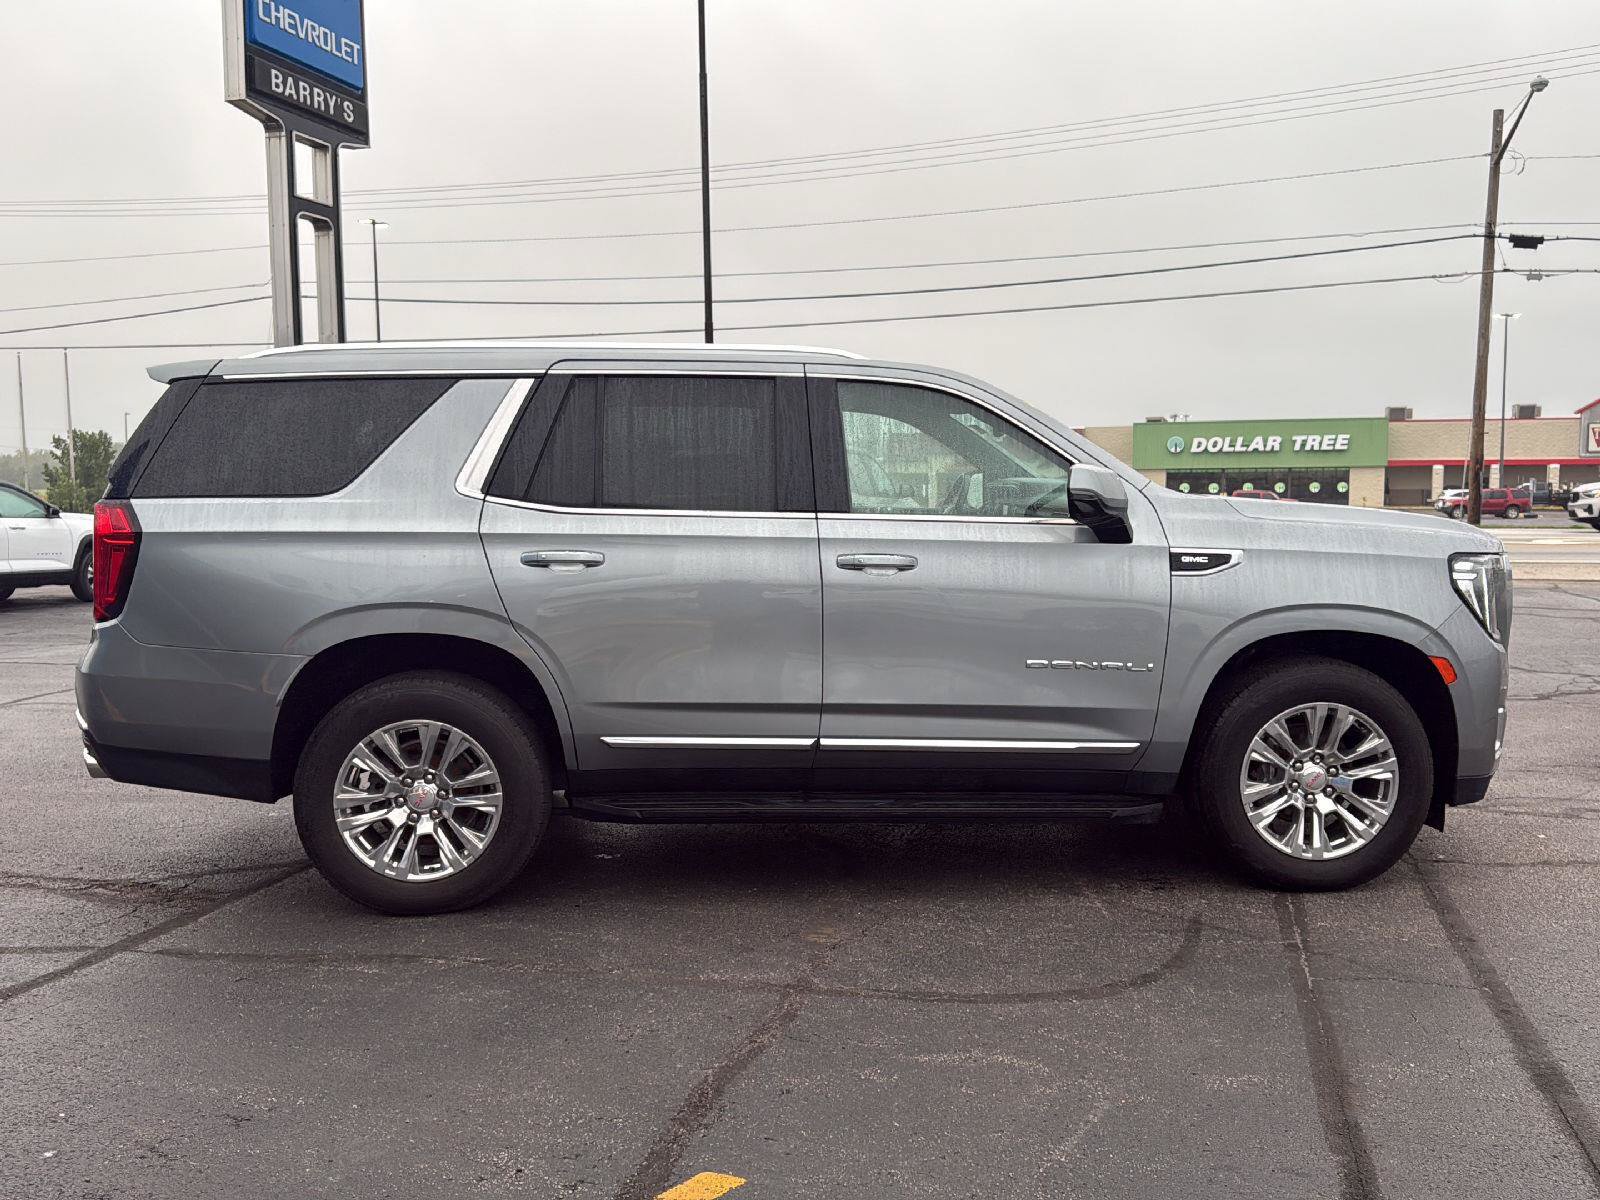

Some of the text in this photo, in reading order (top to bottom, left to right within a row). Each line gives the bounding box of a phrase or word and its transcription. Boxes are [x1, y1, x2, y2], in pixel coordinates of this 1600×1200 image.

[258, 0, 360, 65] CHEVROLET
[270, 68, 355, 123] BARRY'S
[1191, 434, 1350, 453] DOLLAR TREE
[1026, 659, 1154, 671] DENALI
